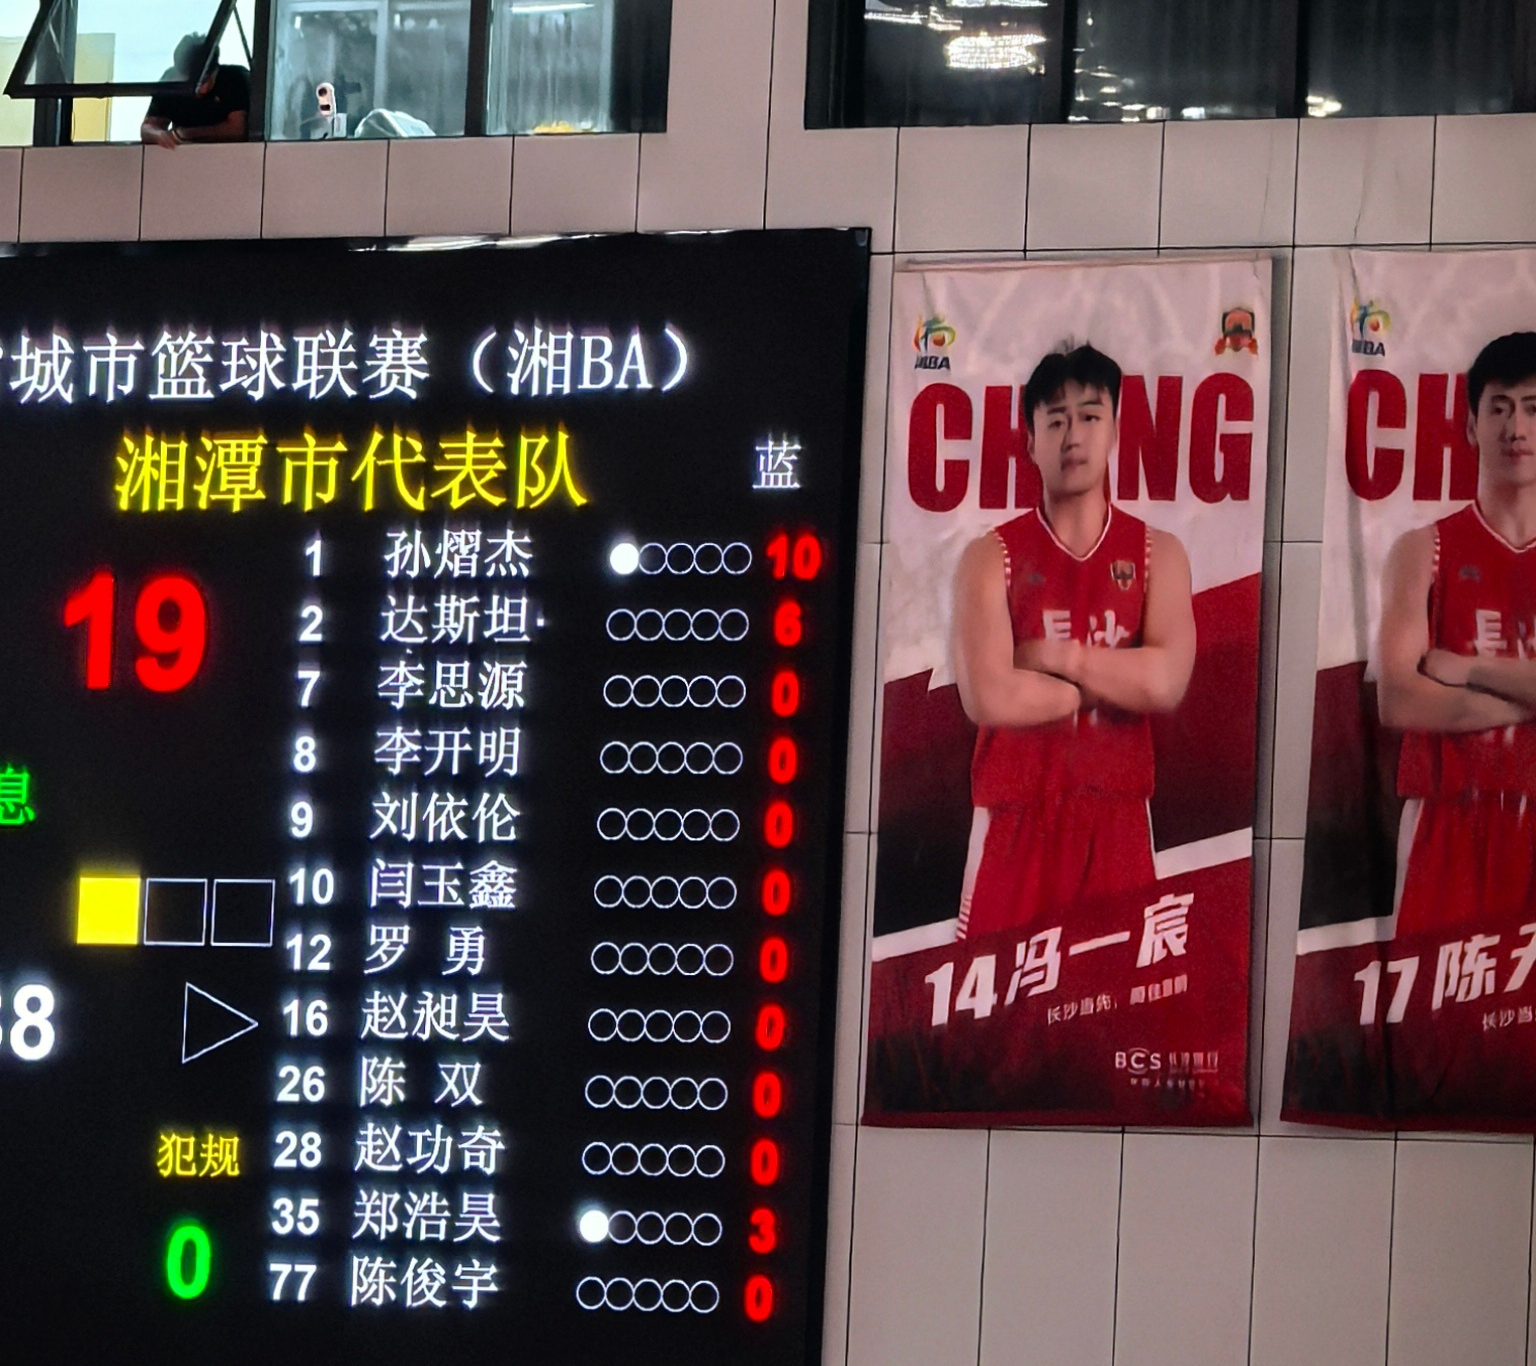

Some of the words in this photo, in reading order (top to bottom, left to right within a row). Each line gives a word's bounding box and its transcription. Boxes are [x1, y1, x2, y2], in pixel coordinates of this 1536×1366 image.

[752, 439, 802, 489] 蓝
[907, 372, 1254, 512] CHNG
[114, 430, 588, 513] 湘潭市代表队
[305, 539, 322, 576] 1
[767, 534, 822, 580] 10
[64, 573, 206, 692] 19
[299, 604, 324, 642] 2
[774, 600, 802, 646] 6
[297, 669, 321, 707] 7
[378, 661, 528, 710] 李思源
[772, 671, 799, 717] 0
[293, 735, 317, 773] 8
[374, 728, 521, 777] 李开明
[769, 737, 797, 784] 0
[290, 800, 314, 838] 9
[370, 791, 521, 843] 刘依伦
[765, 801, 793, 848] 0
[289, 867, 335, 905] 10
[370, 858, 517, 909] 闫玉鑫
[762, 869, 791, 915] 0
[286, 933, 332, 971] 12
[760, 937, 788, 982] 0
[283, 998, 329, 1037] 16
[755, 1004, 786, 1050] 0
[1114, 1049, 1162, 1072] BCS
[276, 1064, 326, 1102] 26
[753, 1072, 782, 1118] 0
[156, 1132, 240, 1178] 犯规
[273, 1130, 322, 1168] 28
[354, 1122, 505, 1175] 赵功奇
[751, 1139, 779, 1185] 0
[271, 1197, 320, 1236] 35
[352, 1189, 501, 1242] 郑浩昊
[749, 1208, 776, 1254] 3
[165, 1221, 212, 1300] 0
[269, 1262, 317, 1301] 77
[351, 1255, 499, 1309] 陈俊宇
[745, 1275, 773, 1321] 0
